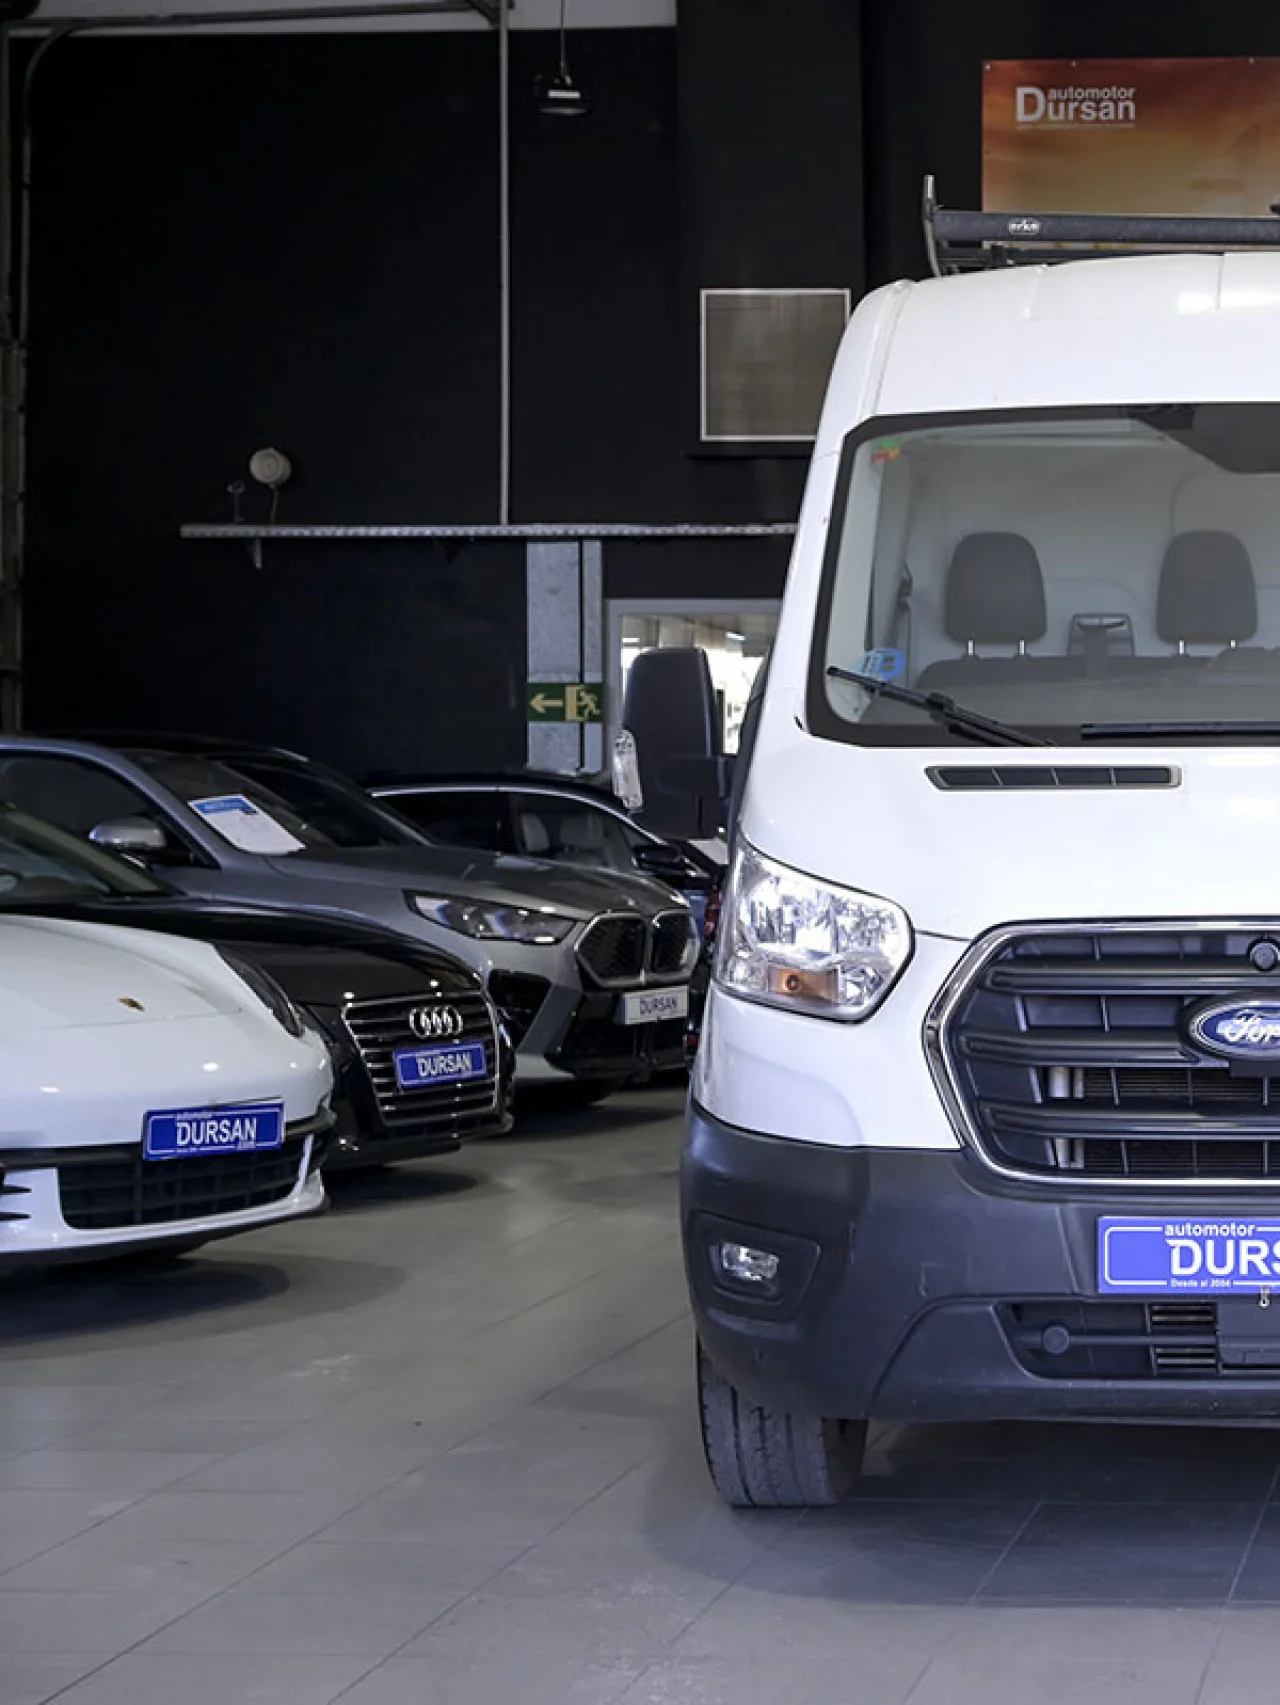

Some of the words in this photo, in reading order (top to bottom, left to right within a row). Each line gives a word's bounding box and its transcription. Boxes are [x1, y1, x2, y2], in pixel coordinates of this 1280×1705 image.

[1015, 86, 1136, 122] Dursan
[1048, 86, 1136, 99] automotor
[417, 1052, 471, 1077] DURSAN
[176, 1117, 257, 1146] DURSAN
[1164, 1222, 1256, 1237] automotor
